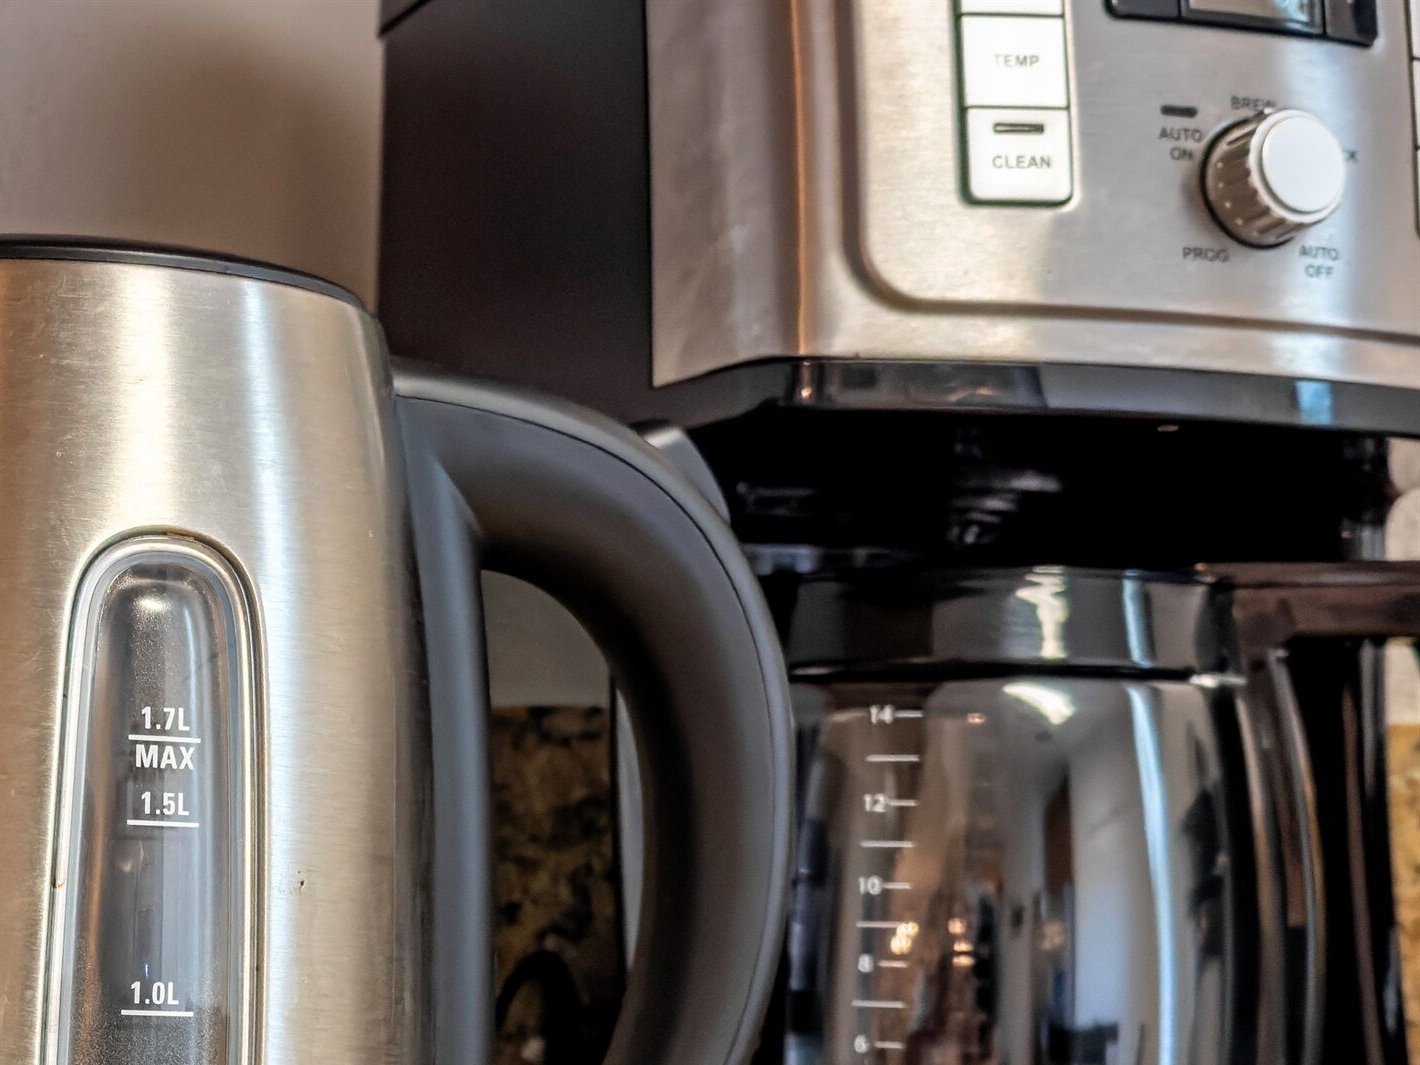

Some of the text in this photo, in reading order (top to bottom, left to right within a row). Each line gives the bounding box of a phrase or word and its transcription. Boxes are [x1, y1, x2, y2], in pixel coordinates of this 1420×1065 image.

[994, 54, 1040, 67] TEMP
[1158, 126, 1204, 142] AUTO
[992, 155, 1052, 169] CLEAN
[1169, 146, 1193, 160] ON
[1182, 247, 1230, 263] PROG
[1298, 245, 1341, 262] AUTO
[1304, 264, 1335, 279] OFF
[140, 707, 190, 731] 1.7L
[868, 705, 894, 724] 14
[135, 745, 195, 770] MAX
[140, 792, 190, 816] 1.5L
[864, 794, 888, 813] 12
[858, 876, 883, 895] 10
[130, 982, 180, 1005] 1.0L
